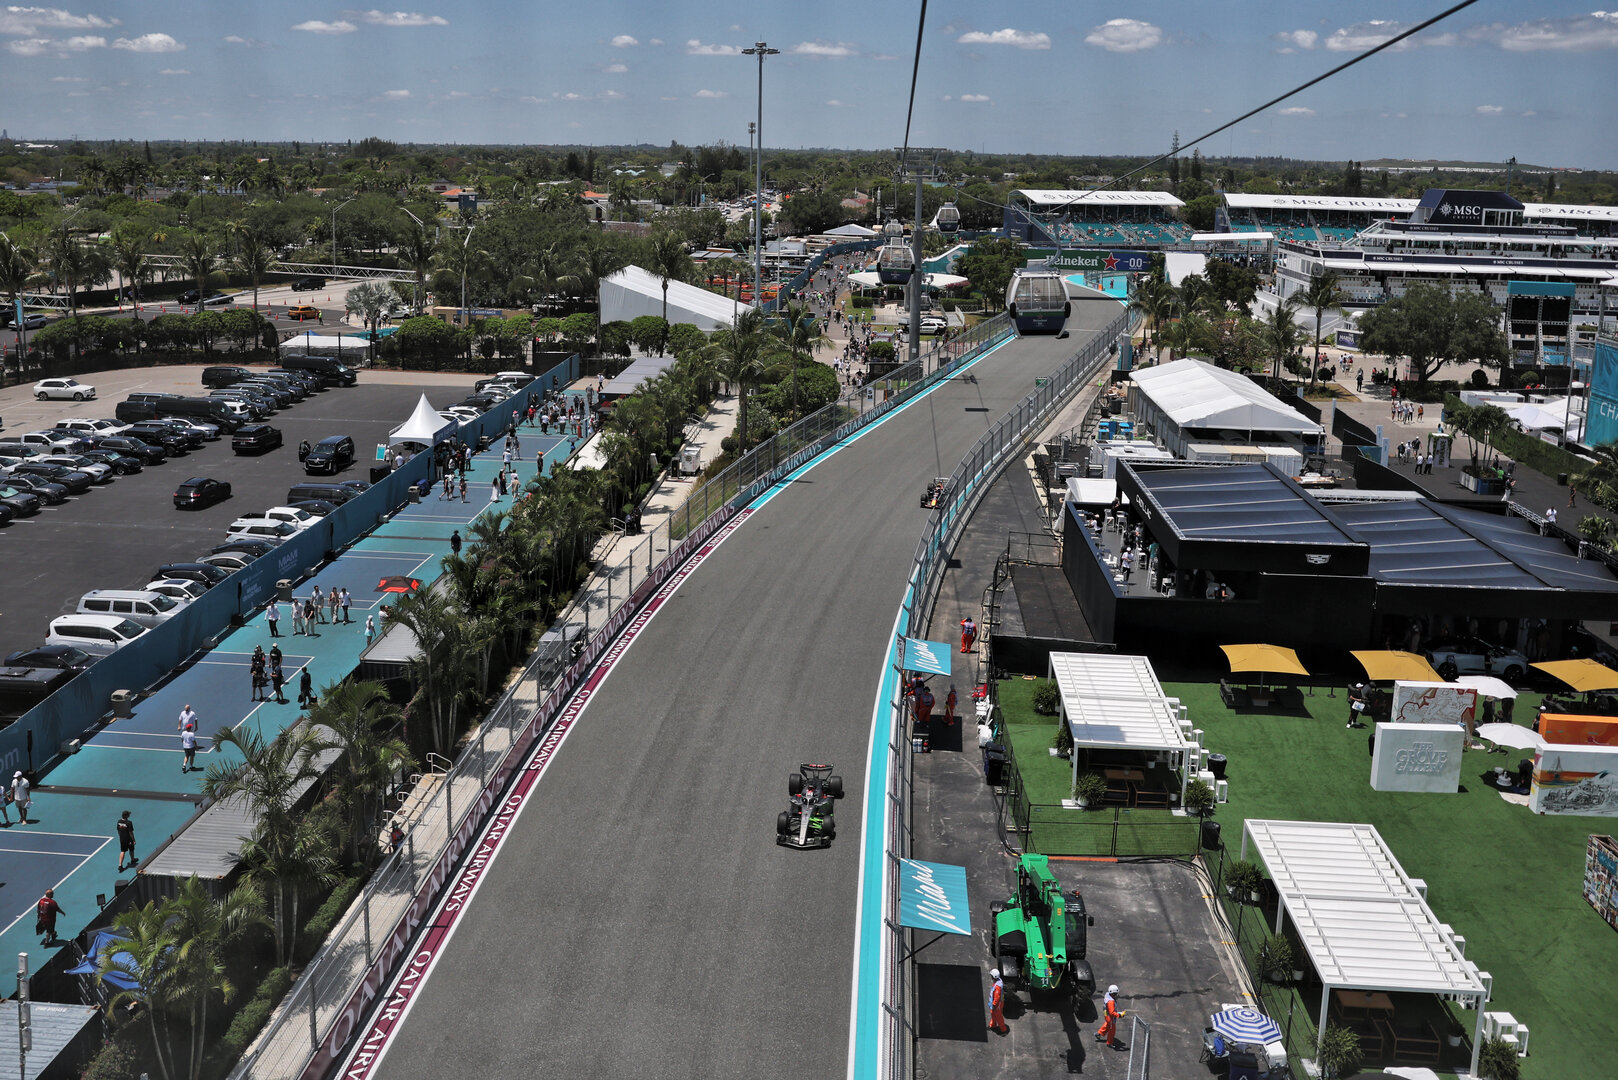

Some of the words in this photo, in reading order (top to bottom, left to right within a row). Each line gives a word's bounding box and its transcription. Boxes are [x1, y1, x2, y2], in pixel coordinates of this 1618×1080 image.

[1334, 200, 1417, 208] CRUISES
[1454, 205, 1481, 216] MSC
[1045, 255, 1098, 267] Heineken
[836, 416, 863, 440] QATAR
[864, 401, 894, 424] AIRWAYS
[1600, 402, 1618, 420] CH
[751, 464, 783, 497] QATAR
[784, 441, 822, 474] AIRWAYS
[654, 541, 691, 585] QATAR
[692, 501, 736, 548] AIRWAYS
[627, 609, 653, 637] QATAR
[532, 662, 580, 739] QATAR
[581, 601, 636, 673] AIRWAYS
[600, 634, 633, 668] AIRWAYS
[560, 689, 591, 722] QATAR
[529, 723, 567, 770] AIRWAYS
[486, 794, 523, 840] QATAR
[445, 843, 493, 913] AIRWAYS
[900, 857, 972, 936] Miami
[330, 901, 420, 1059] QATAR
[426, 774, 505, 910] AIRWAYS
[379, 950, 433, 1022] QATAR
